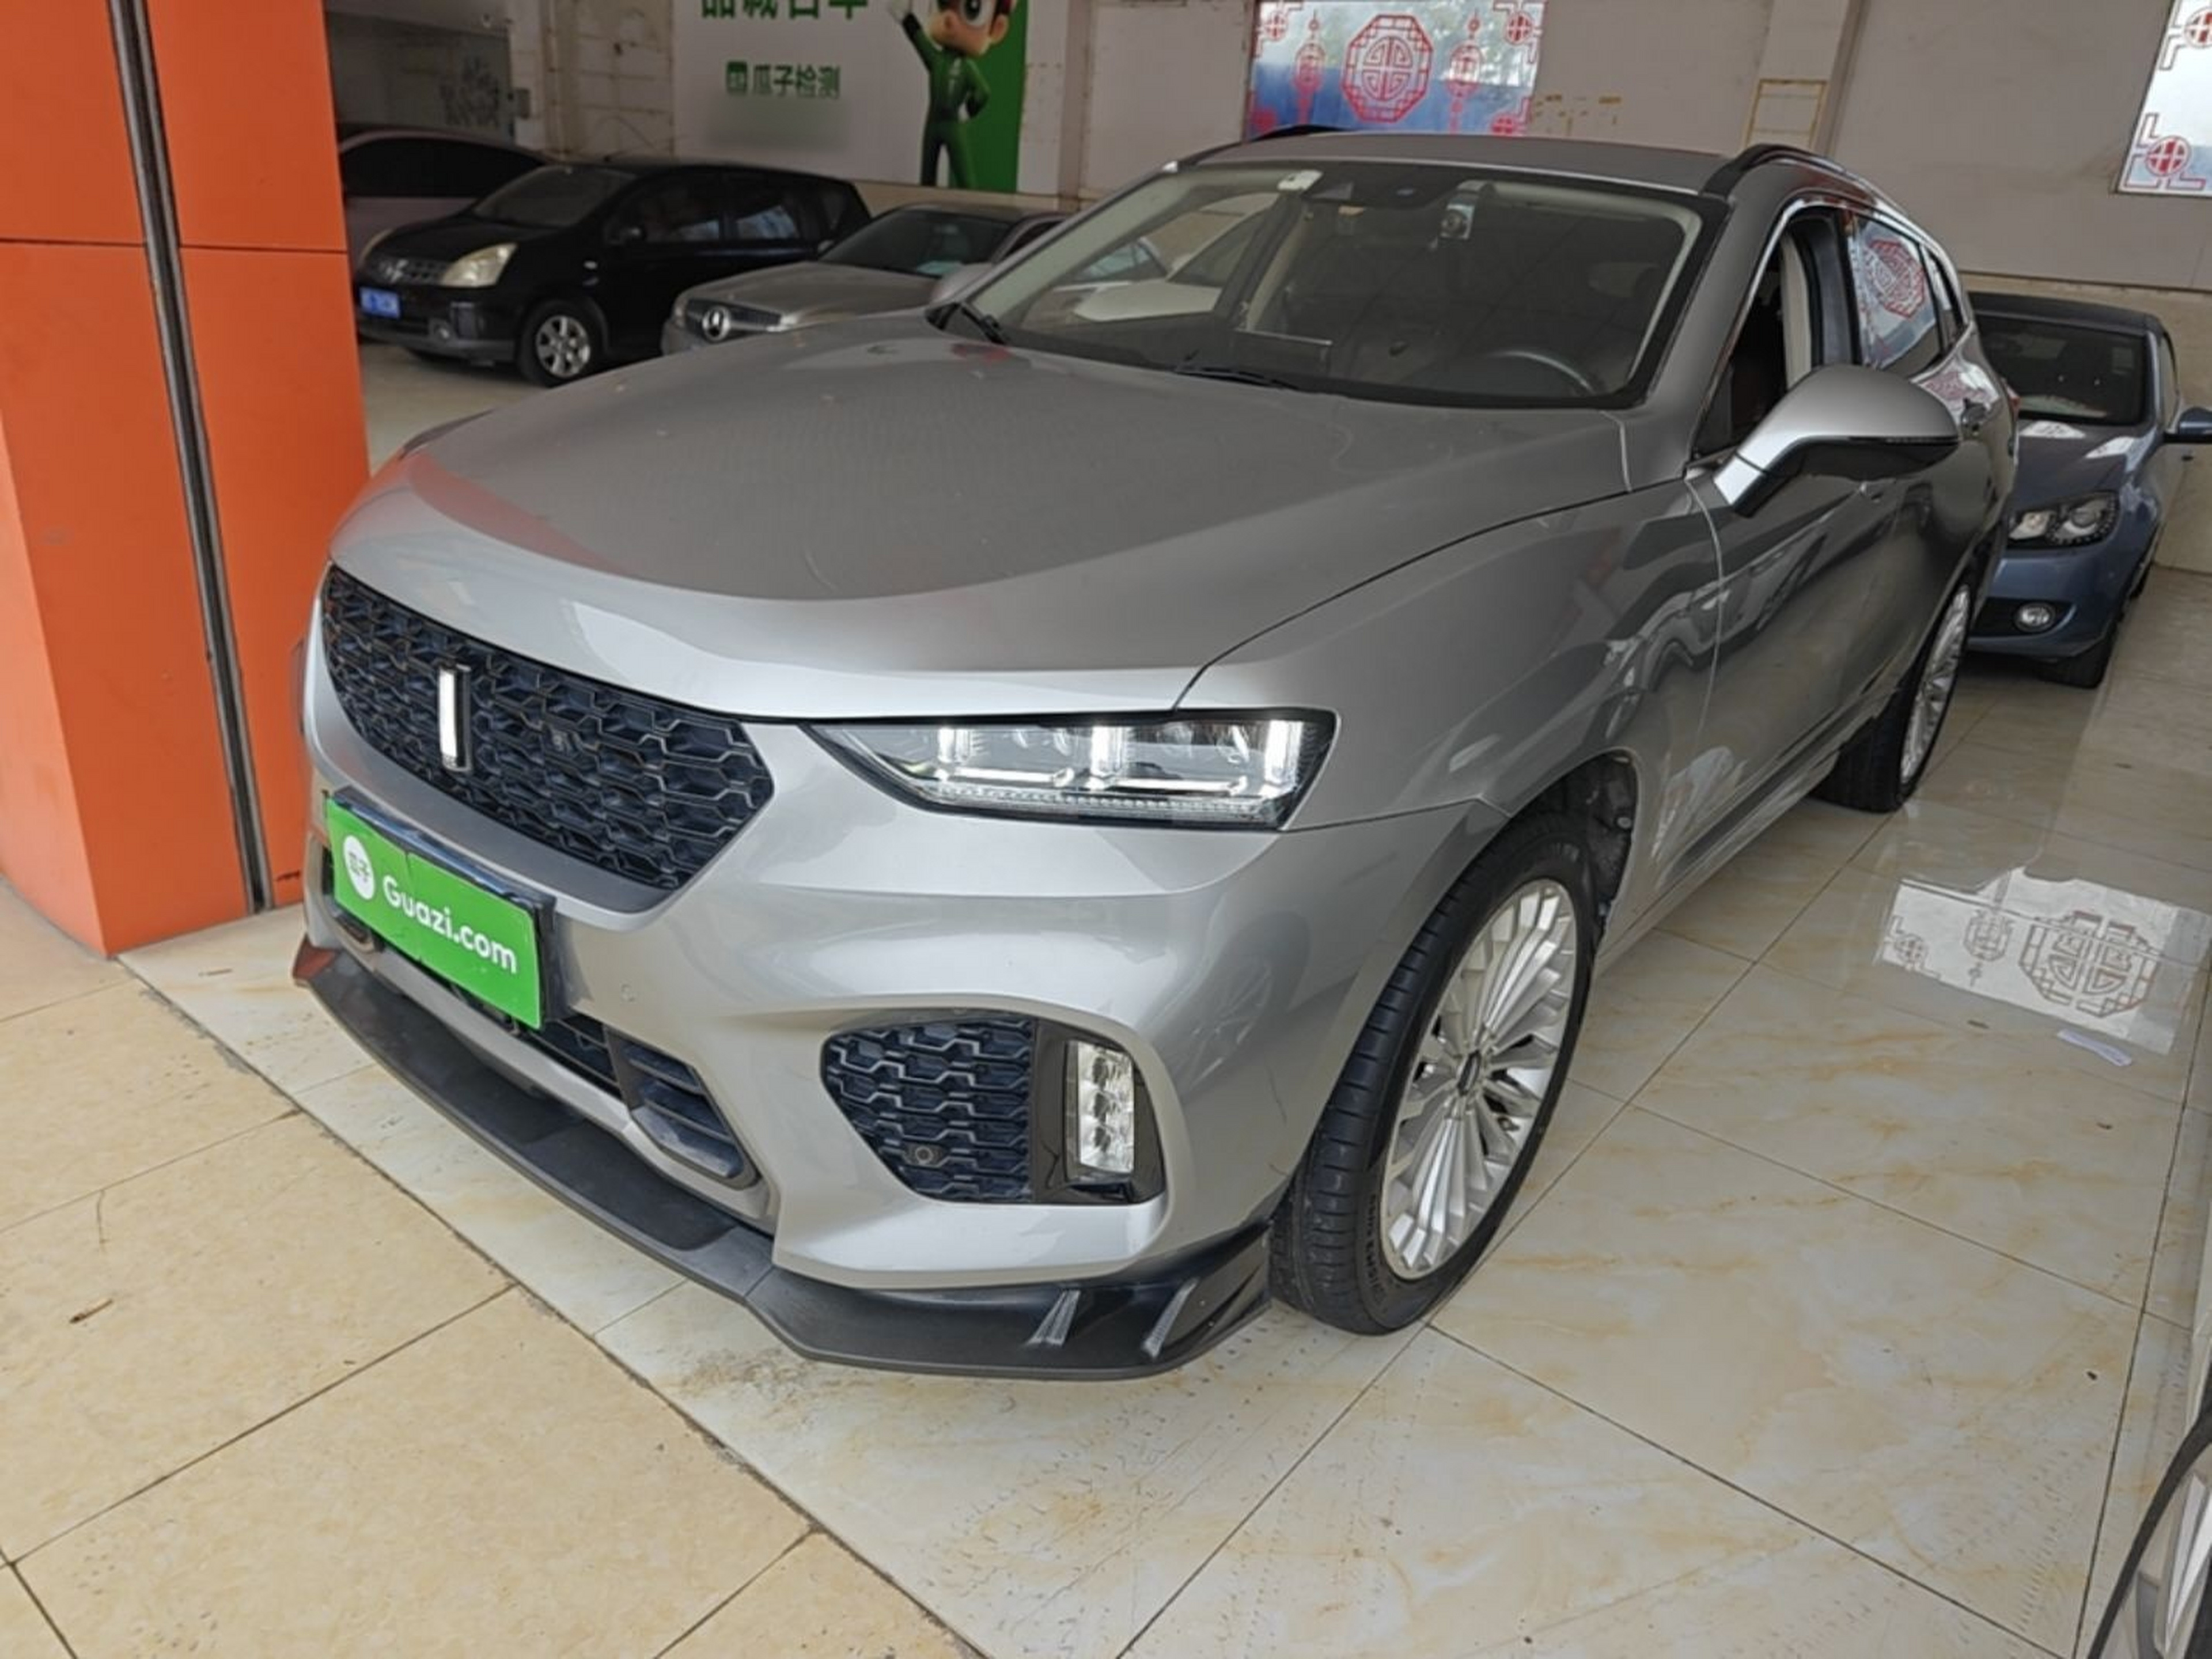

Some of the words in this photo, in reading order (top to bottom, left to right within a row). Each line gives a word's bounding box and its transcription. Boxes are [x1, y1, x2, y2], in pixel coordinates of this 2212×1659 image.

[752, 64, 840, 99] 瓜子检测
[382, 875, 517, 974] Guazi.com
